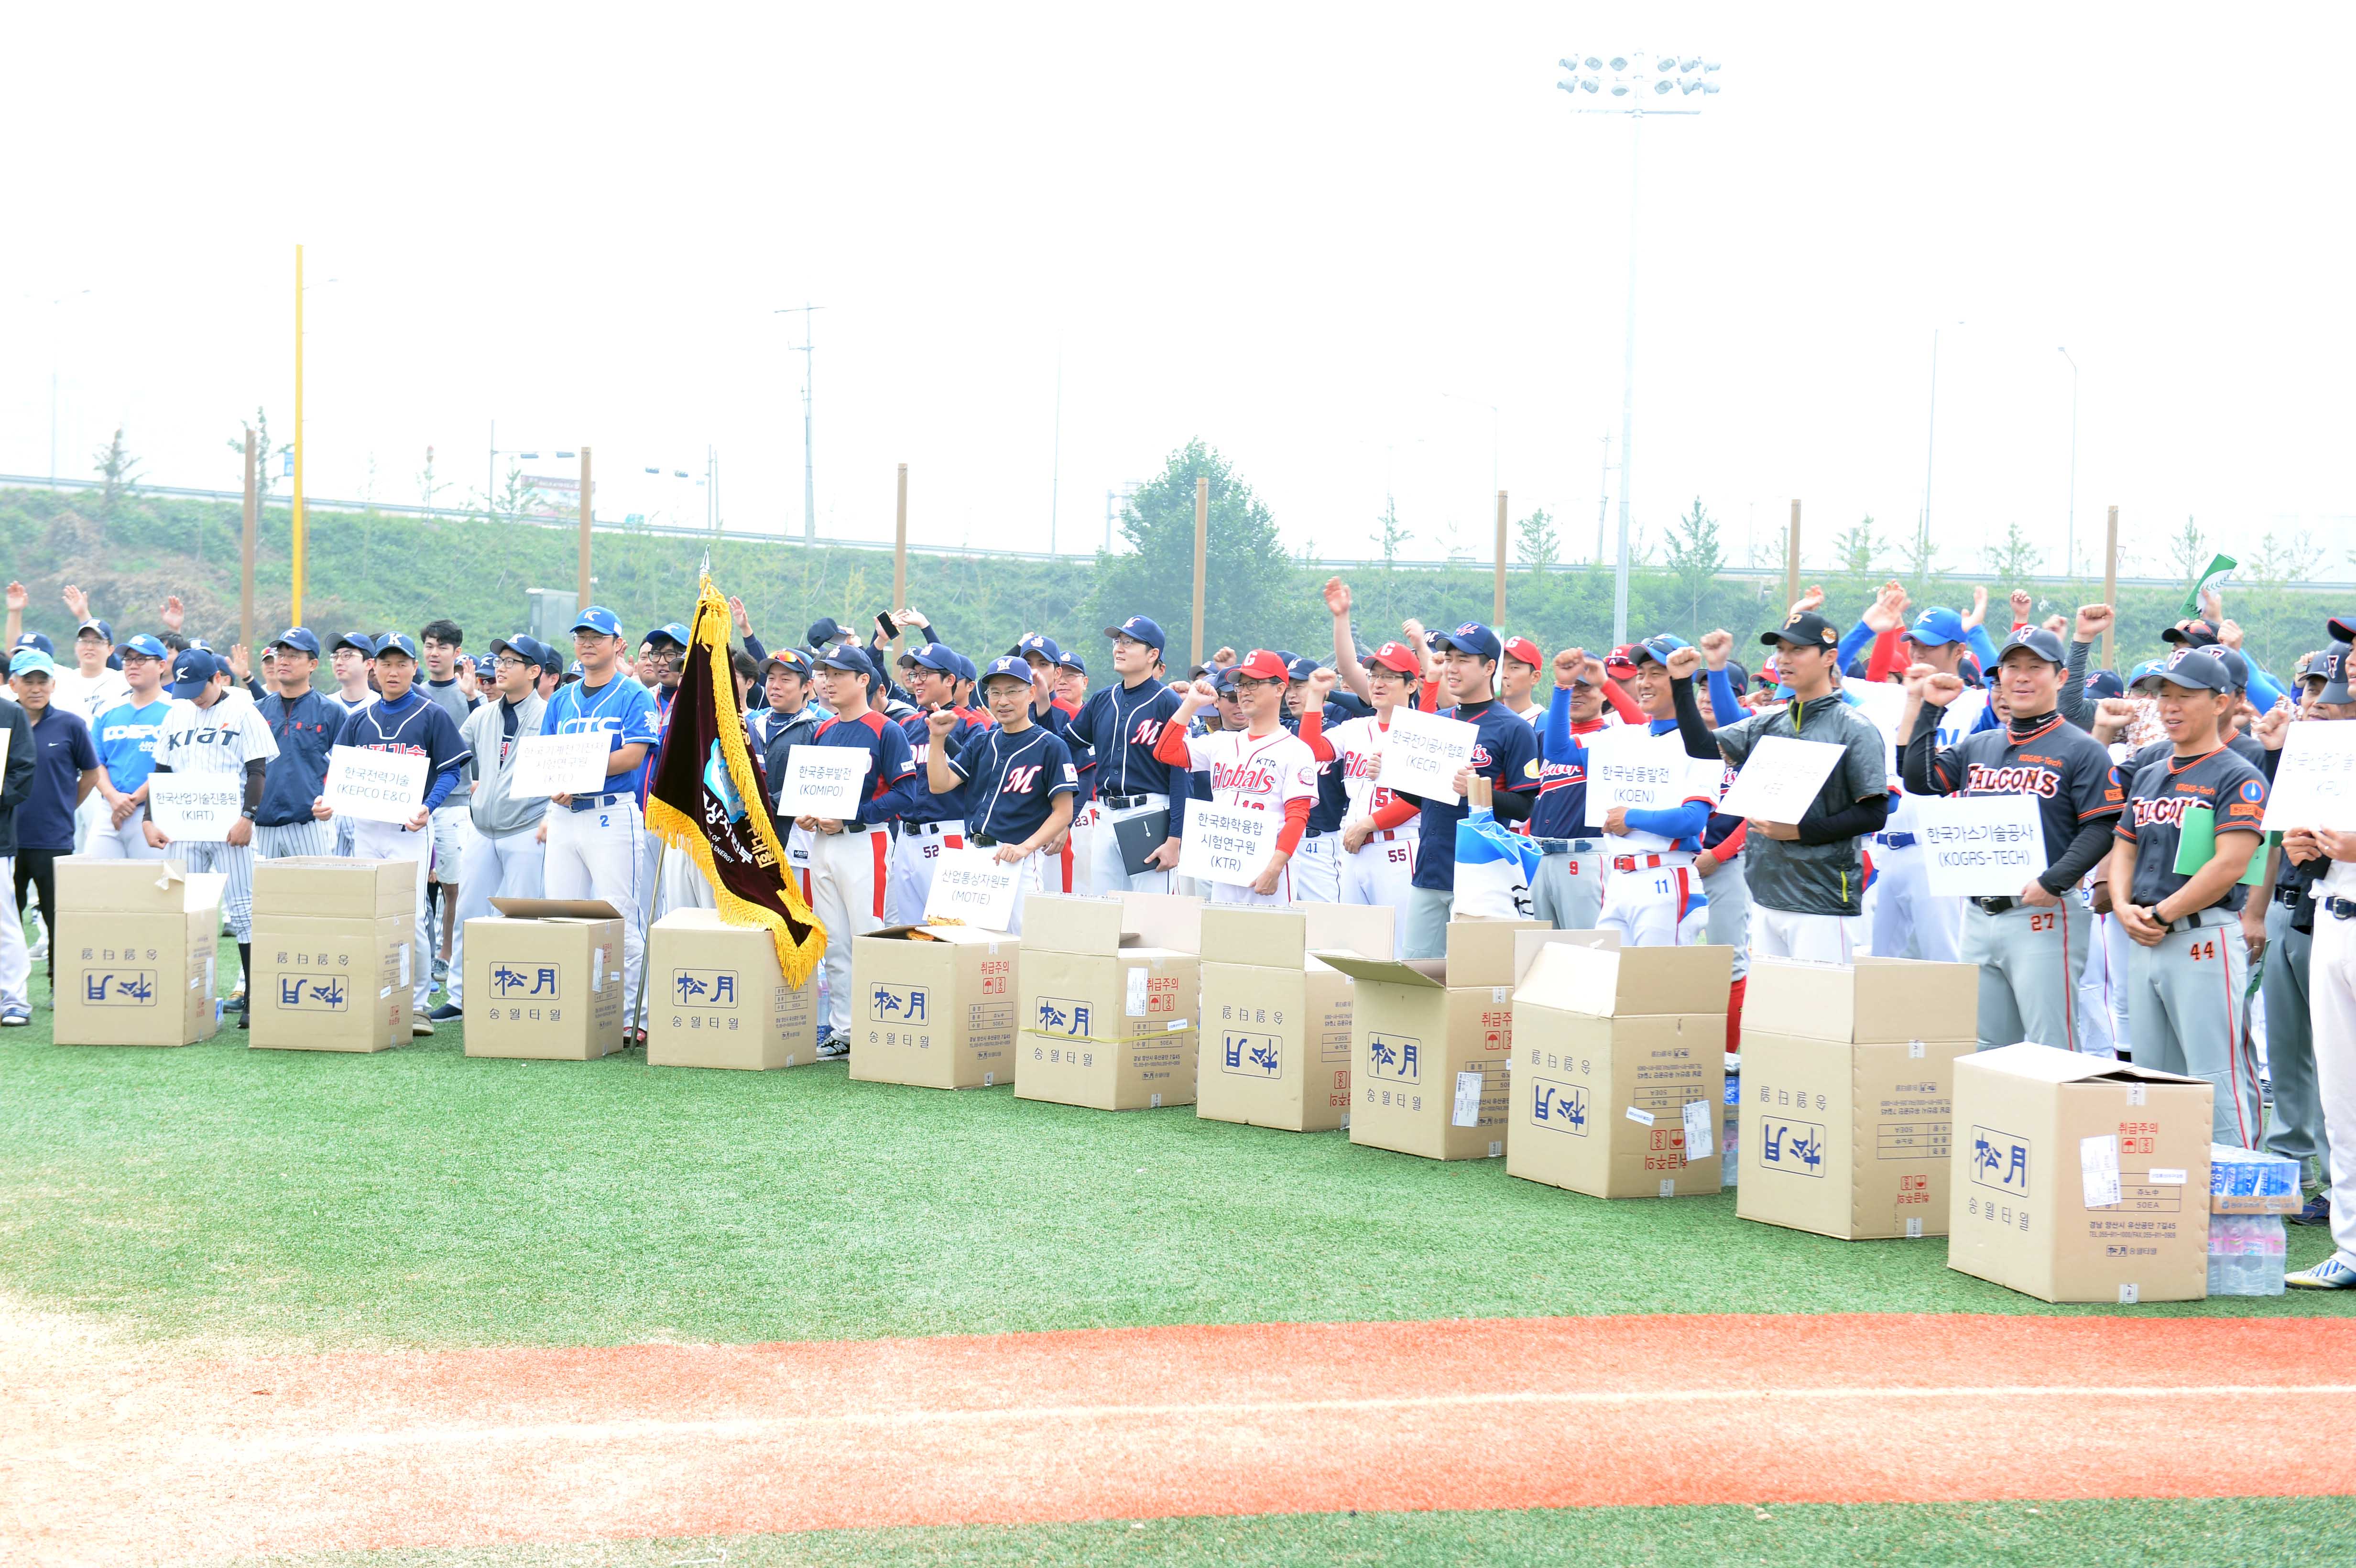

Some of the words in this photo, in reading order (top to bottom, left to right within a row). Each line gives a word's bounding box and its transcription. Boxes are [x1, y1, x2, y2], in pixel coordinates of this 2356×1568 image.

[1784, 614, 1802, 630] P
[388, 633, 401, 645] K
[1505, 636, 1521, 648] G
[2017, 625, 2038, 643] F
[1380, 642, 1395, 656] G
[1244, 651, 1258, 666] G
[2169, 650, 2190, 670] F
[1129, 718, 1163, 746] M
[1393, 730, 1466, 760] 한국전기공사협회
[1256, 757, 1276, 769] KTR
[1406, 755, 1440, 774] (KECA)
[344, 766, 410, 787] 한국전력기술
[799, 765, 852, 781] 한국중부발전
[1003, 765, 1043, 794] M
[1212, 762, 1276, 795] Globals
[1602, 765, 1669, 783] 한국남동발전
[156, 792, 238, 805] 한국산업기술진흥원
[337, 784, 380, 798] (KEPCO
[382, 790, 411, 804] E&C)
[800, 784, 843, 797] (KOMIPO)
[1614, 789, 1655, 804] (KOEN)
[182, 811, 214, 821] (KIAT)
[600, 815, 610, 827] 2
[1074, 816, 1089, 827] 23
[1198, 812, 1264, 836] 한국화학융합
[1926, 824, 2034, 844] 한국가스기술공사
[923, 845, 939, 859] 52
[1201, 833, 1255, 855] 시험연구원
[1306, 842, 1318, 854] 41
[713, 844, 735, 864] ENERGY
[1211, 855, 1241, 871] (KTR)
[1388, 849, 1407, 862] 55
[1939, 850, 2030, 867] (KOGAS-TECH)
[1569, 861, 1578, 875] 9
[942, 869, 1010, 889] 산업통상자원부
[1655, 879, 1669, 894] 11
[951, 890, 991, 906] (MOTIE)
[2030, 912, 2055, 932] 27
[2190, 941, 2214, 961] 44
[980, 960, 1009, 975] 취급주의
[88, 972, 152, 1003] 松月
[494, 964, 555, 997] 松月
[677, 971, 734, 1004] 松月
[1146, 978, 1178, 991] 취급주의
[283, 977, 344, 1009] 松月
[874, 986, 925, 1020] 松月
[1039, 1001, 1089, 1036] 松月
[1481, 1012, 1512, 1027] 취급주
[1226, 1036, 1278, 1075] 松月
[1371, 1036, 1417, 1078] 松月
[1535, 1085, 1585, 1131] 松月
[2119, 1122, 2158, 1134] 취급주의
[1765, 1124, 1821, 1172] 松月
[1974, 1132, 2026, 1188] 松月
[1897, 1192, 1930, 1205] 취급주의
[2127, 1221, 2154, 1230] 유산공단
